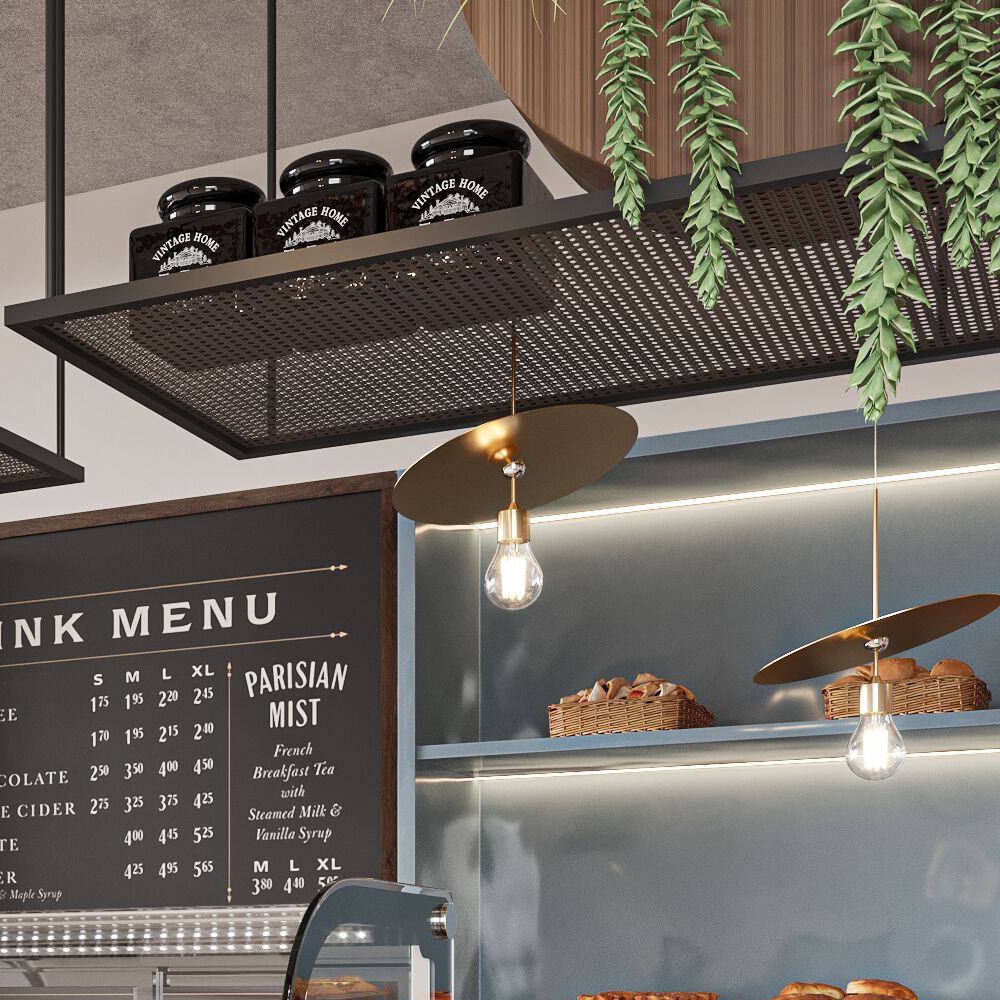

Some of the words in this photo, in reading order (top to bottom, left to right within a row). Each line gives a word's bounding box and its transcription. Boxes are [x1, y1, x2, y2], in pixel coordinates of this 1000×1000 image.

[411, 178, 456, 210] VINTAGE
[458, 178, 489, 200] HOME
[276, 206, 318, 237] VINTAGE
[320, 206, 349, 227] HOME
[152, 232, 191, 261] VINTAGE
[193, 232, 220, 253] HOME
[112, 592, 278, 639] MENU
[93, 674, 103, 686] S
[125, 671, 140, 684] M
[162, 668, 172, 680] L
[192, 664, 215, 678] XL
[245, 661, 348, 697] PARISIAN
[269, 698, 321, 728] MIST
[274, 742, 313, 757] French
[253, 762, 308, 782] Breakfast
[313, 761, 335, 776] Tea
[281, 785, 305, 799] with
[17, 802, 76, 818] CIDER
[248, 806, 296, 821] Steamed
[299, 804, 326, 819] Milk
[330, 803, 342, 817] &
[256, 827, 295, 841] Vanilla
[298, 826, 332, 844] Syrup
[253, 861, 269, 873] M
[289, 860, 300, 872] L
[316, 858, 342, 871] XL
[9, 889, 35, 902] Maple
[37, 888, 62, 901] Syrup
